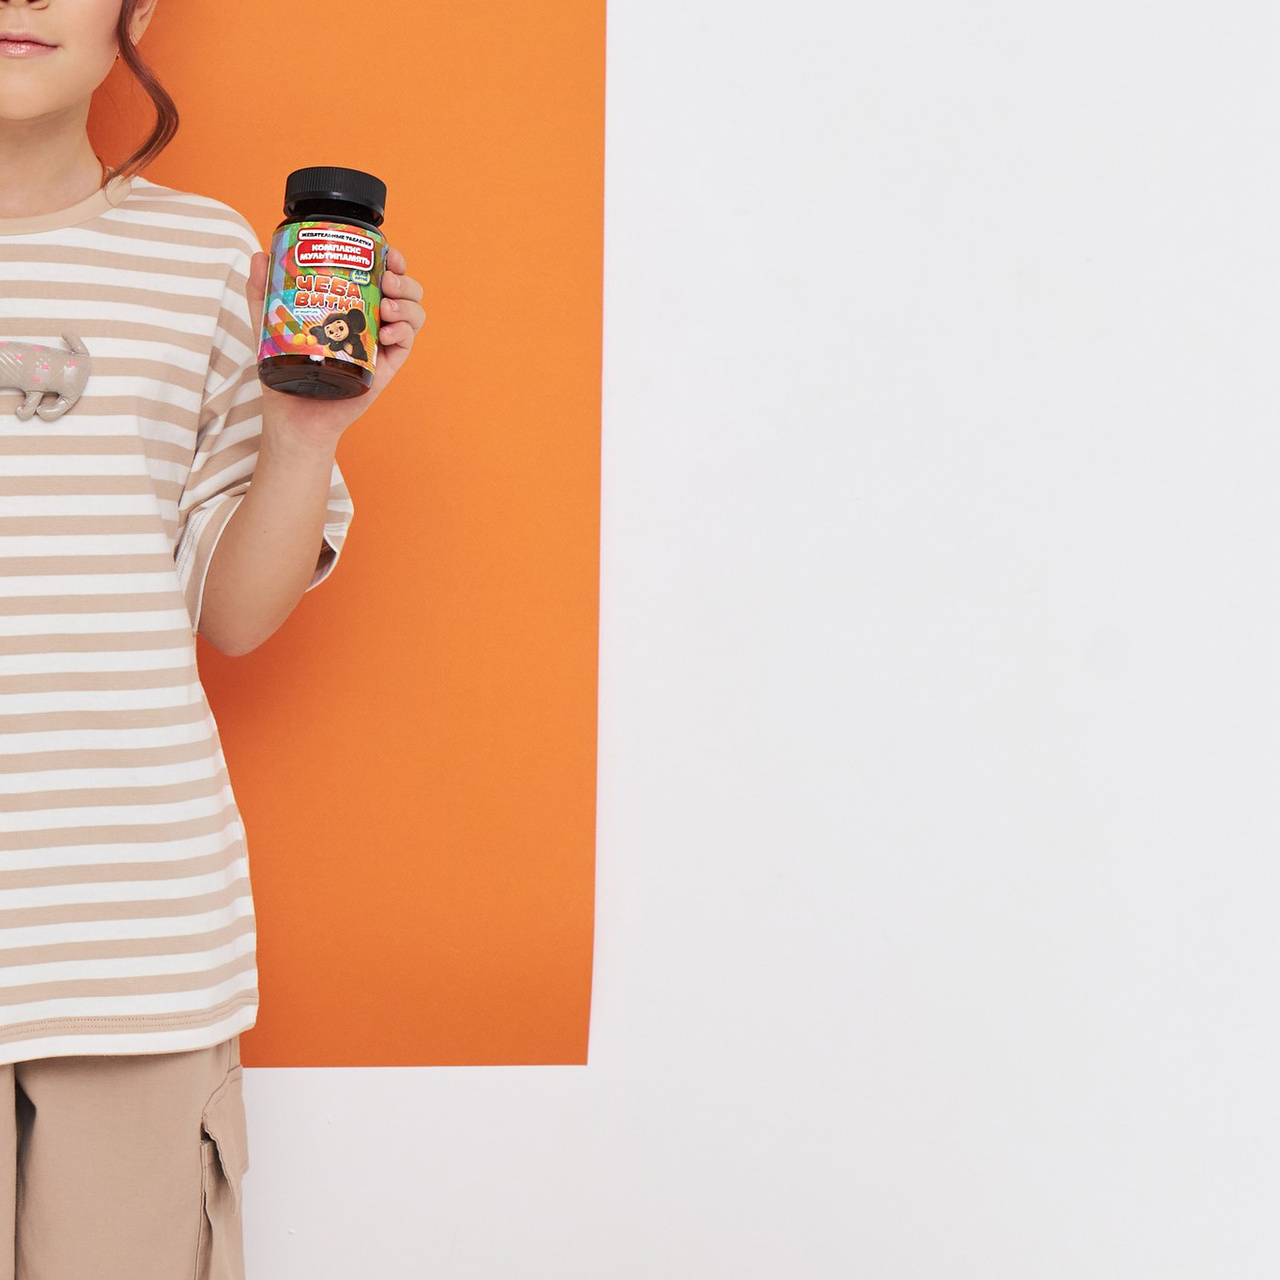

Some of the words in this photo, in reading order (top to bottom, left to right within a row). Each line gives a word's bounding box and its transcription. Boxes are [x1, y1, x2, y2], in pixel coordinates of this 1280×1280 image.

[311, 244, 361, 254] КОМПЛЕКС
[299, 252, 370, 265] МУЛЬТИПАМЯТЬ
[296, 275, 361, 299] ЧЕБА
